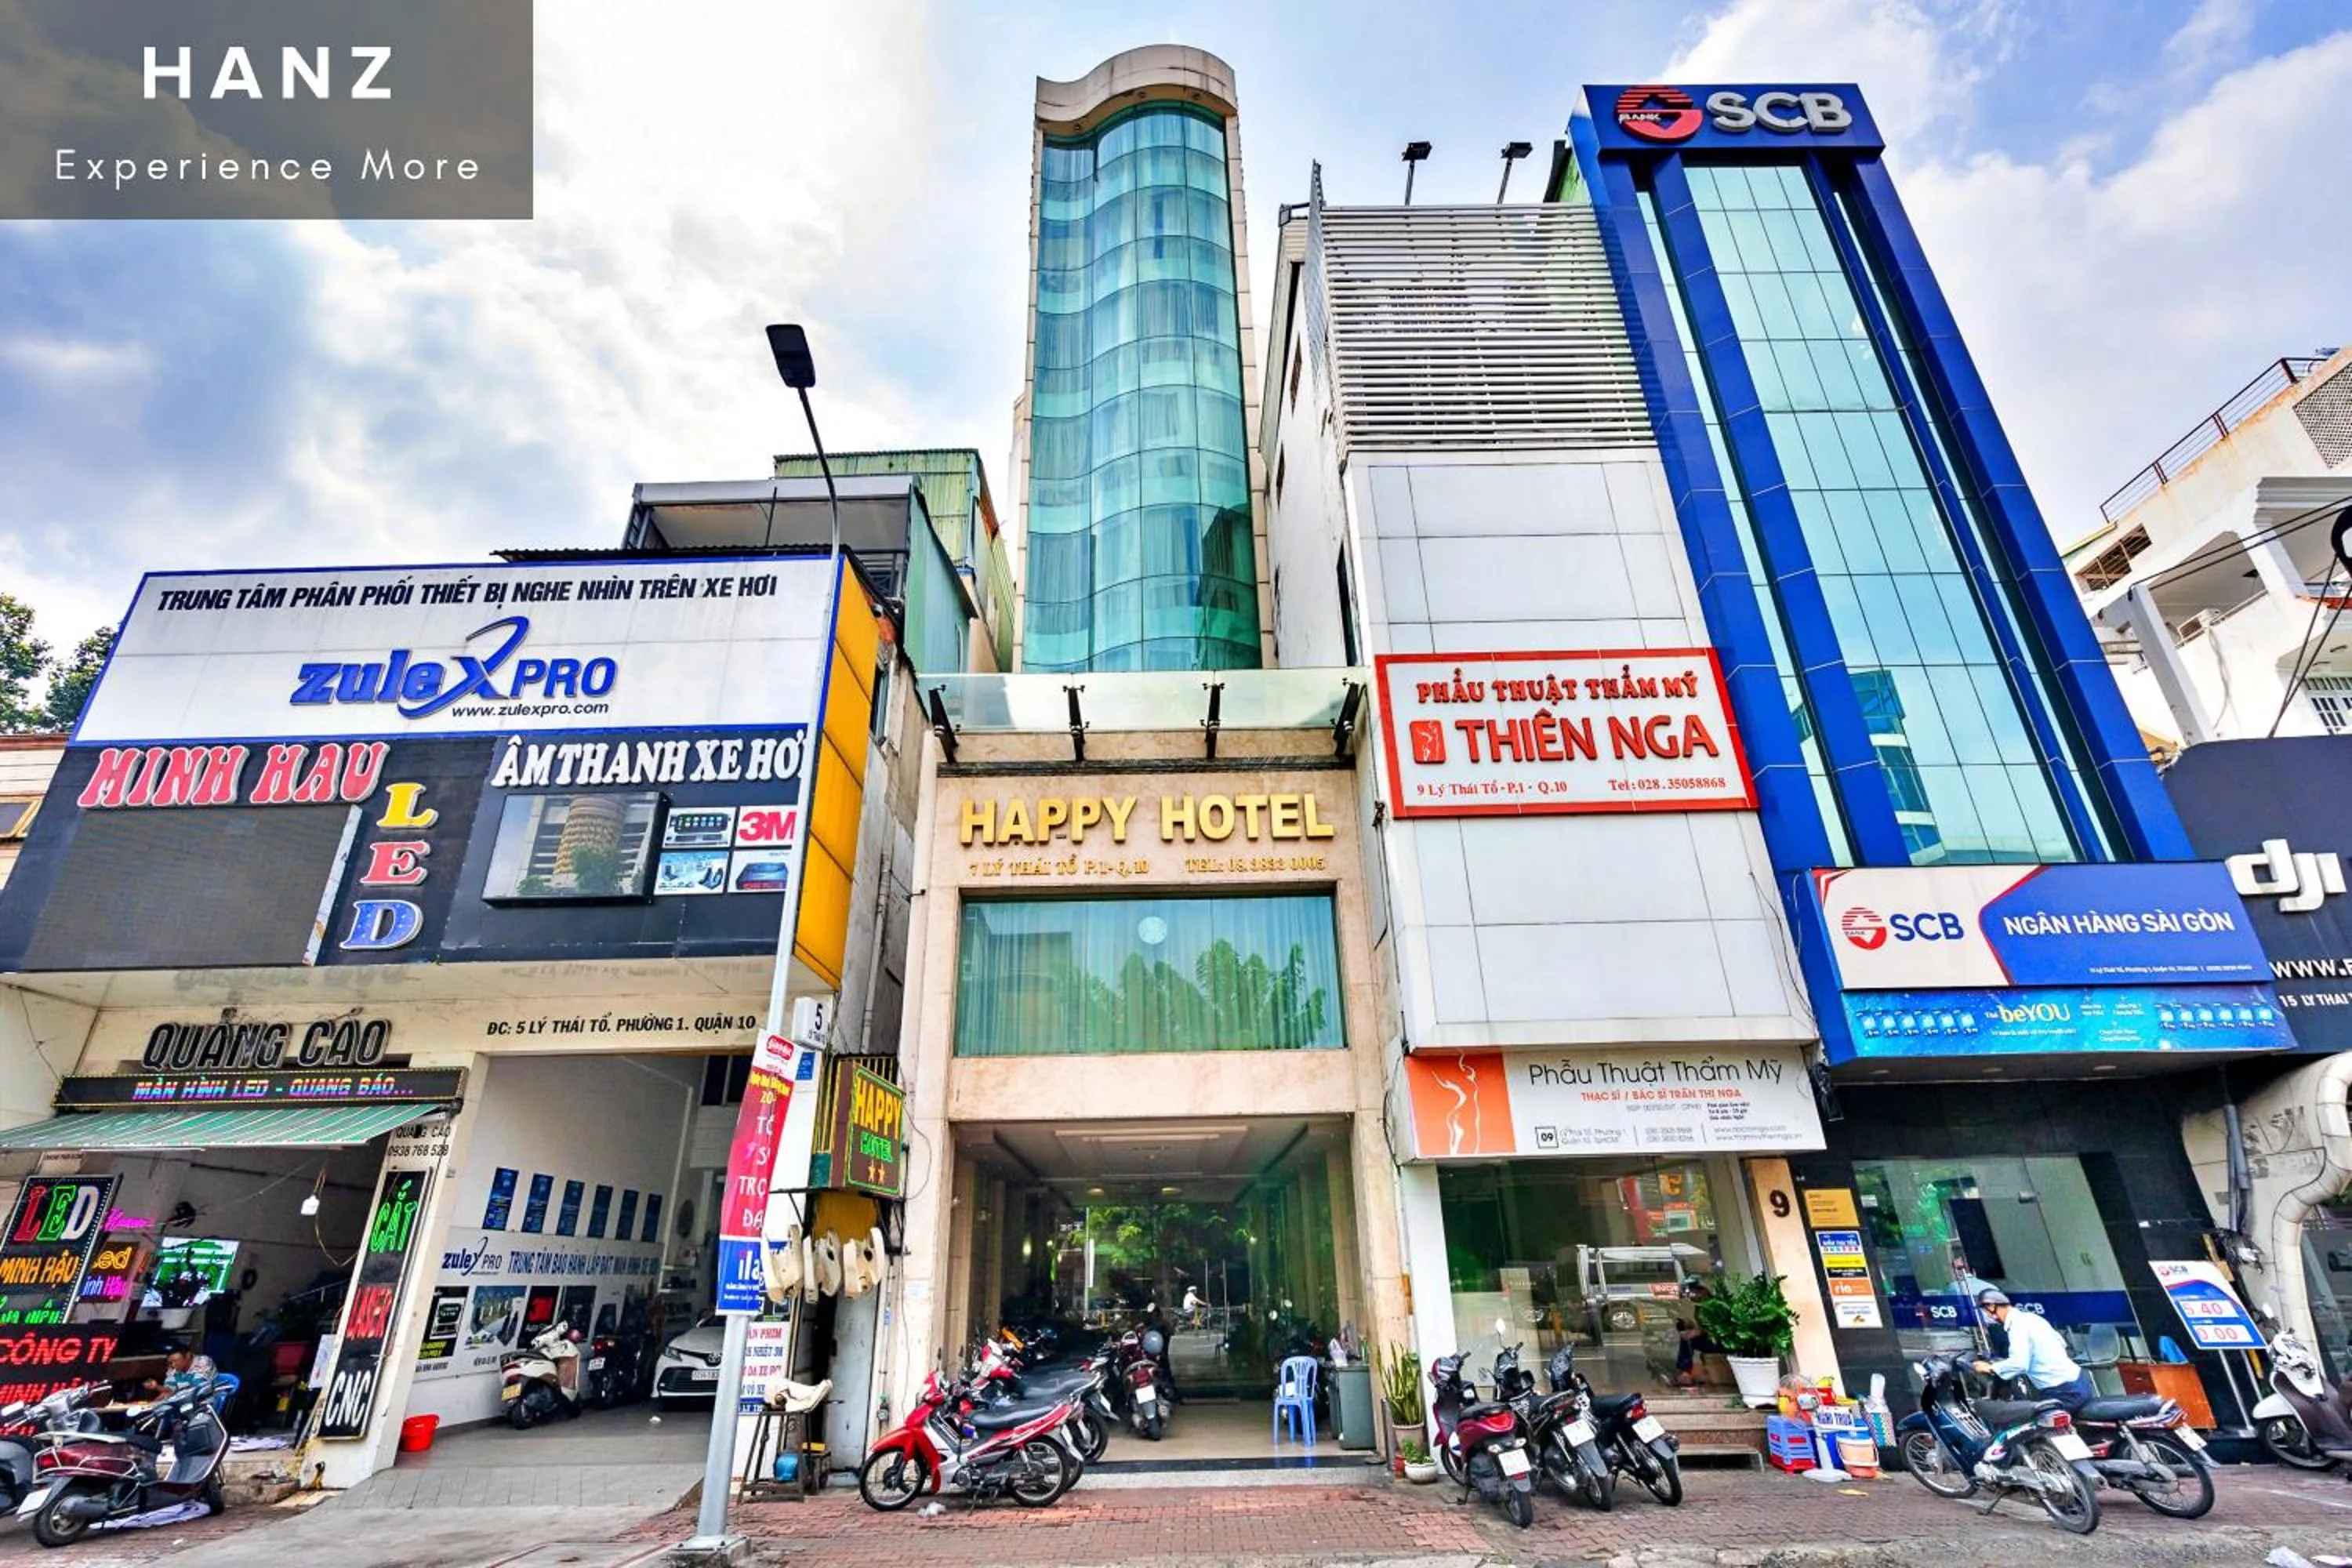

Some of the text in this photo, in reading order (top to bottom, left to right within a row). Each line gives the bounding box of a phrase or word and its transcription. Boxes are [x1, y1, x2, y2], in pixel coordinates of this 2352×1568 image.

[1706, 92, 1852, 132] SCB
[158, 574, 777, 610] TRUNG TÂM PHÂN PHỐI THIẾT BỊ NGHE NHÌN TRÊN XE HƠI
[1492, 673, 1577, 705] THUẬT
[452, 704, 608, 717] www.zulexpro.com
[1455, 708, 1719, 762] THIÊN NGA
[492, 735, 557, 787] ÂM
[556, 741, 695, 785] THANH
[691, 739, 744, 782] XE
[78, 745, 249, 810] MINH
[1417, 782, 1425, 795] 9
[1428, 783, 1445, 797] Lý
[1450, 782, 1478, 795] Thái
[739, 811, 797, 841] 3M
[960, 792, 1335, 845] HAPPY HOTEL
[1889, 909, 2235, 941] SCB NGÂN HÀNG SÀI GÒN
[1998, 1004, 2071, 1023] beYOU
[2279, 995, 2297, 1007] 15
[487, 1022, 513, 1035] ĐC:
[515, 1021, 526, 1034] 5
[528, 1015, 548, 1034] LÝ
[552, 1015, 585, 1033] THÁI
[616, 1012, 673, 1032] PHƯỜNG
[695, 1012, 733, 1034] QUẬN
[738, 1015, 757, 1030] 10
[815, 1004, 822, 1031] 5
[1529, 1056, 1782, 1087] Phẫu Thuật Thẩm Mỹ
[231, 1080, 269, 1098] LED
[1717, 1089, 1741, 1098] NGA
[854, 1076, 902, 1141] HAPPY
[1541, 1133, 1555, 1142] 09
[14, 1185, 99, 1241] LED
[1770, 1189, 1791, 1218] 9
[1930, 1305, 1958, 1319] SCB
[87, 1337, 118, 1363] TY
[325, 1370, 372, 1428] CNC
